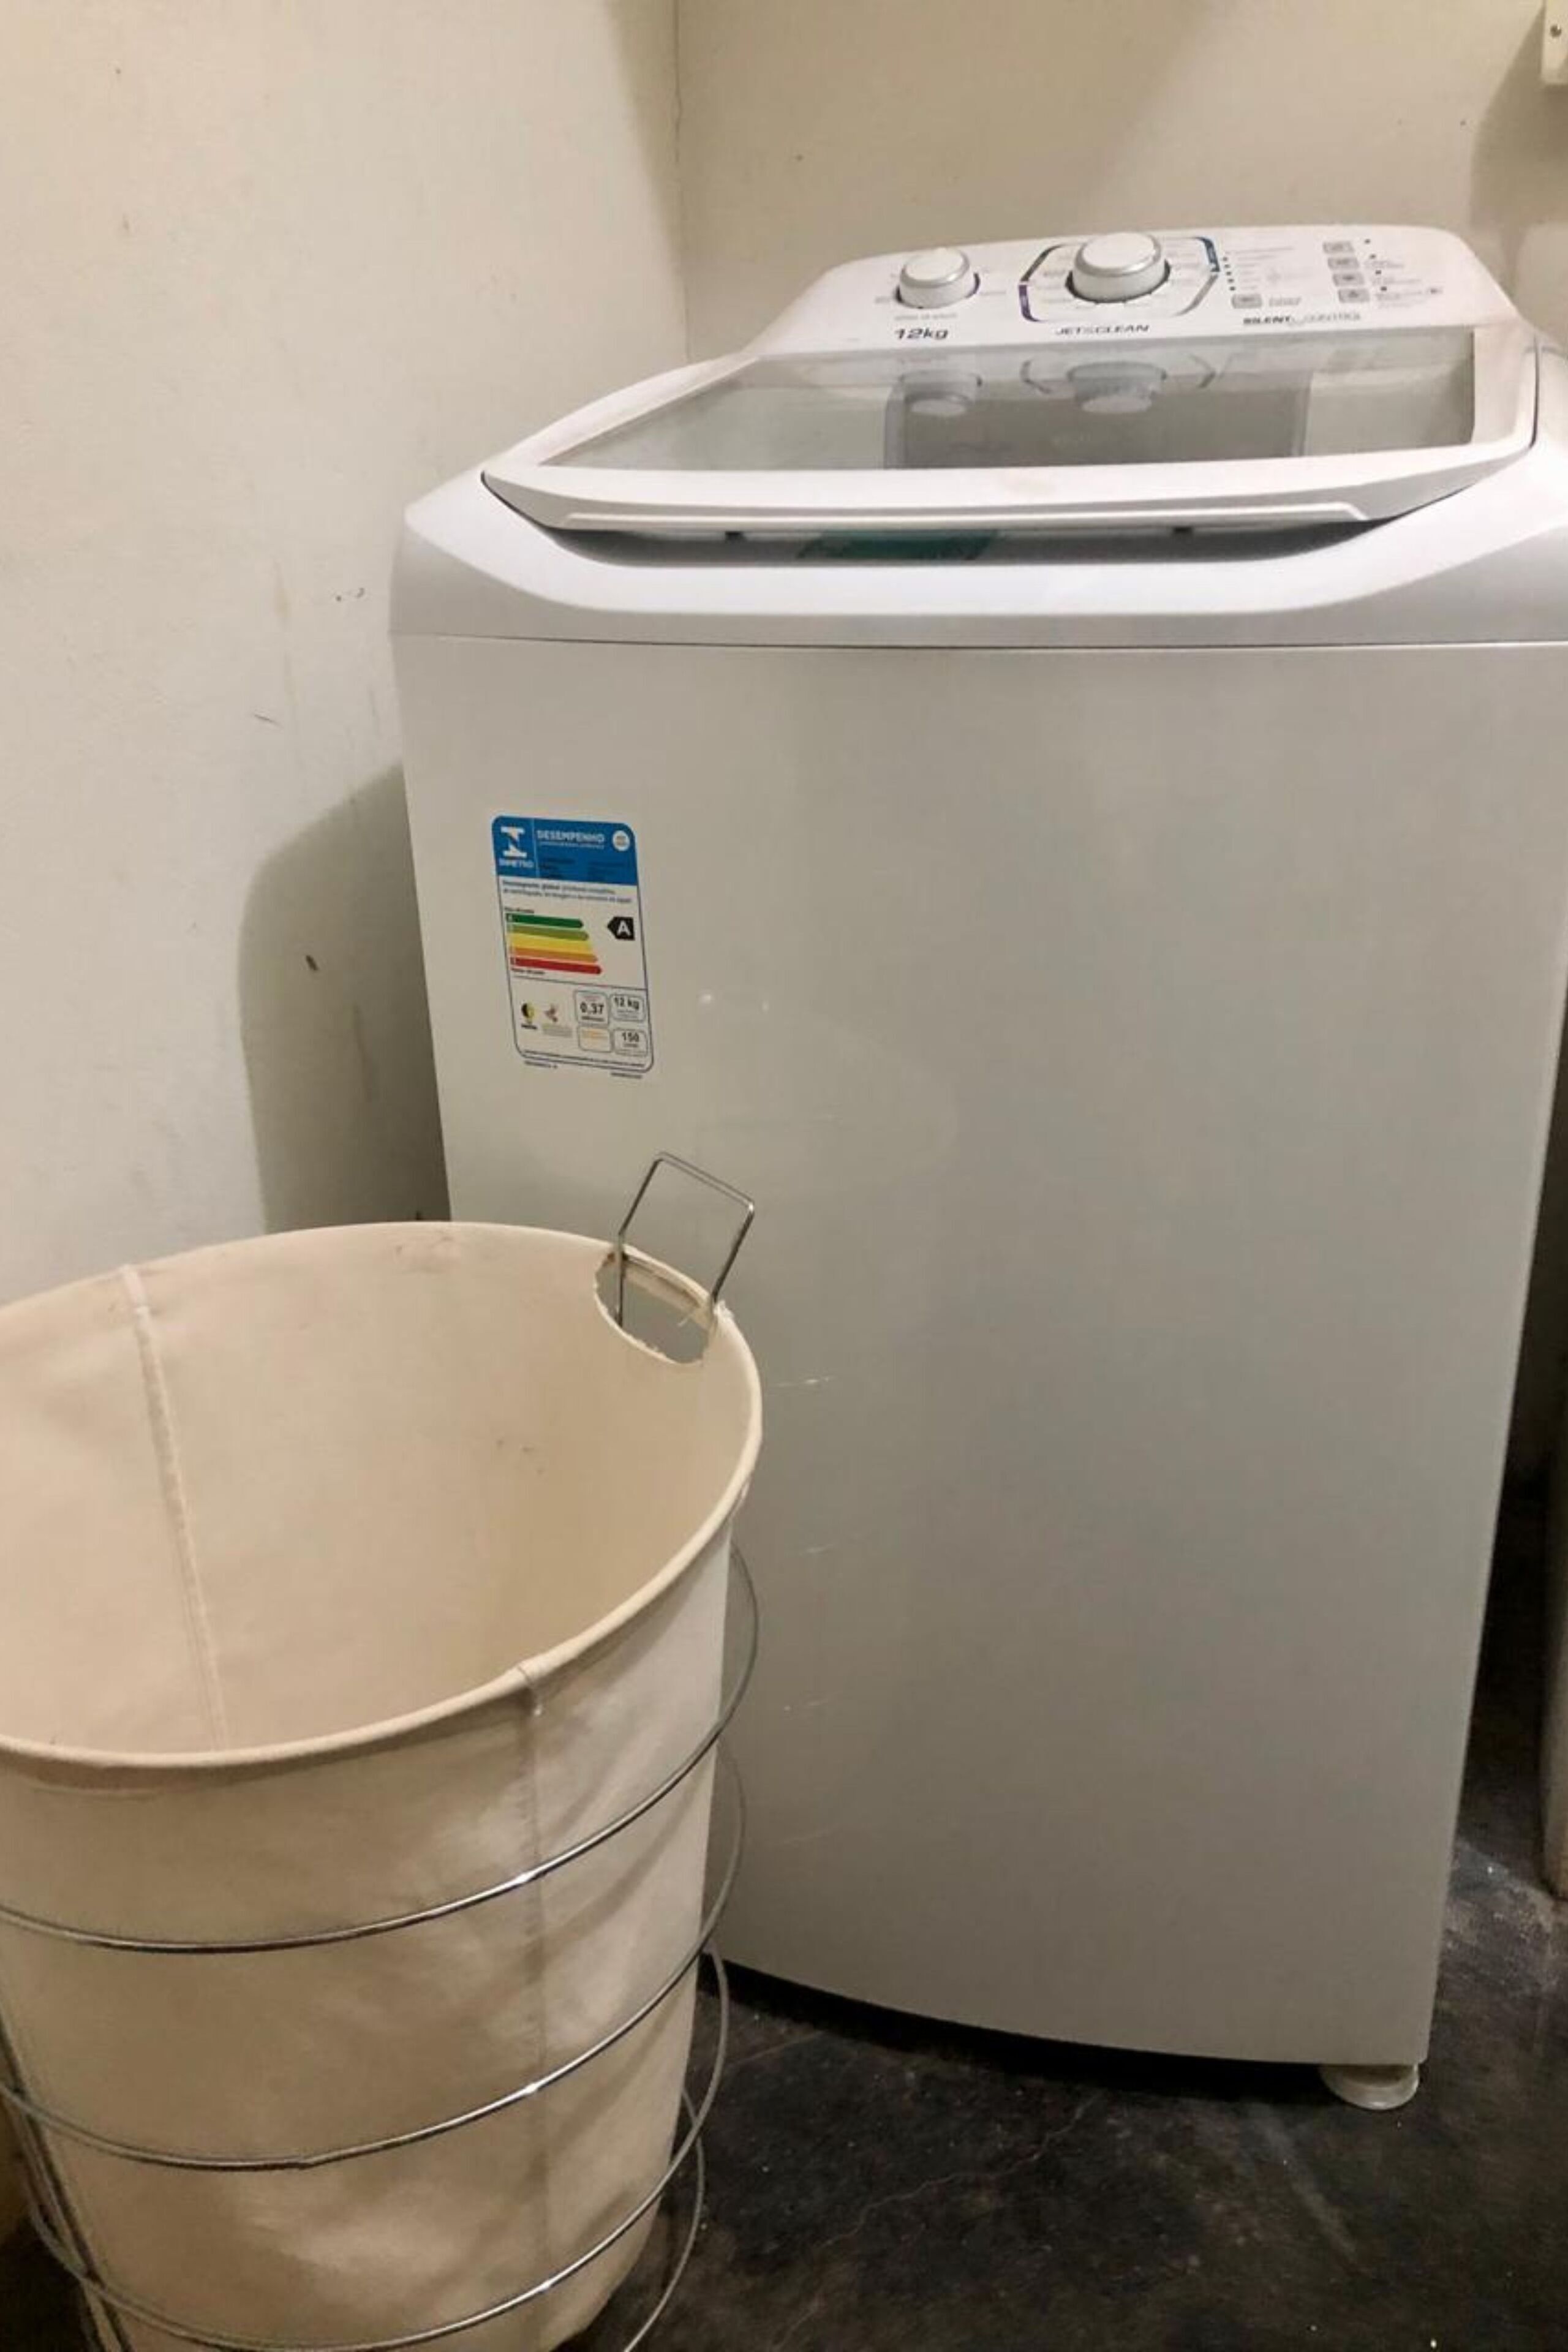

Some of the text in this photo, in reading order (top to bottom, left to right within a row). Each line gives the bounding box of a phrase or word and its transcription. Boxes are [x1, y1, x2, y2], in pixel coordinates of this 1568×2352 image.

[894, 328, 949, 341] 12kg
[537, 830, 605, 843] DESEMPENHO
[616, 920, 631, 936] A
